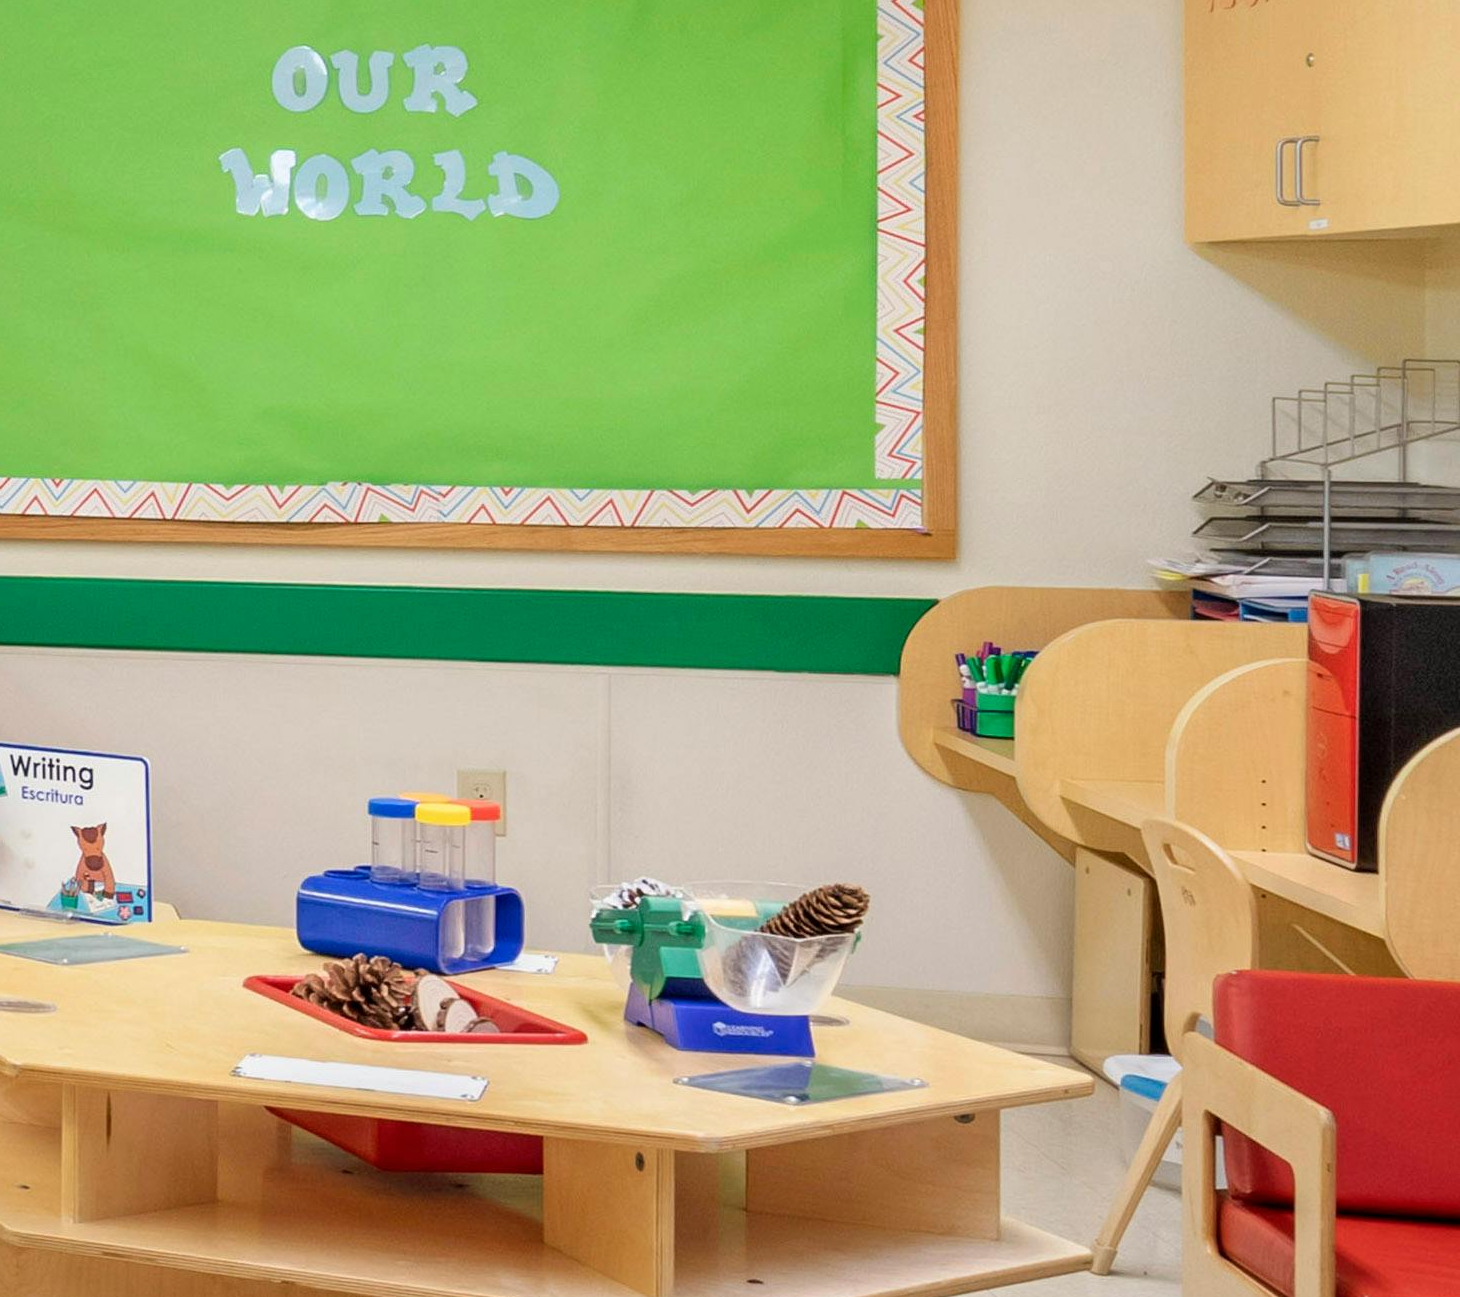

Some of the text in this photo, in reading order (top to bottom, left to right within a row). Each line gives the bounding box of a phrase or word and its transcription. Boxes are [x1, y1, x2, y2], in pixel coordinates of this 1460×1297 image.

[271, 44, 479, 118] OUR
[218, 148, 560, 221] WORLD
[10, 753, 94, 790] Writing
[21, 786, 84, 805] Escritura
